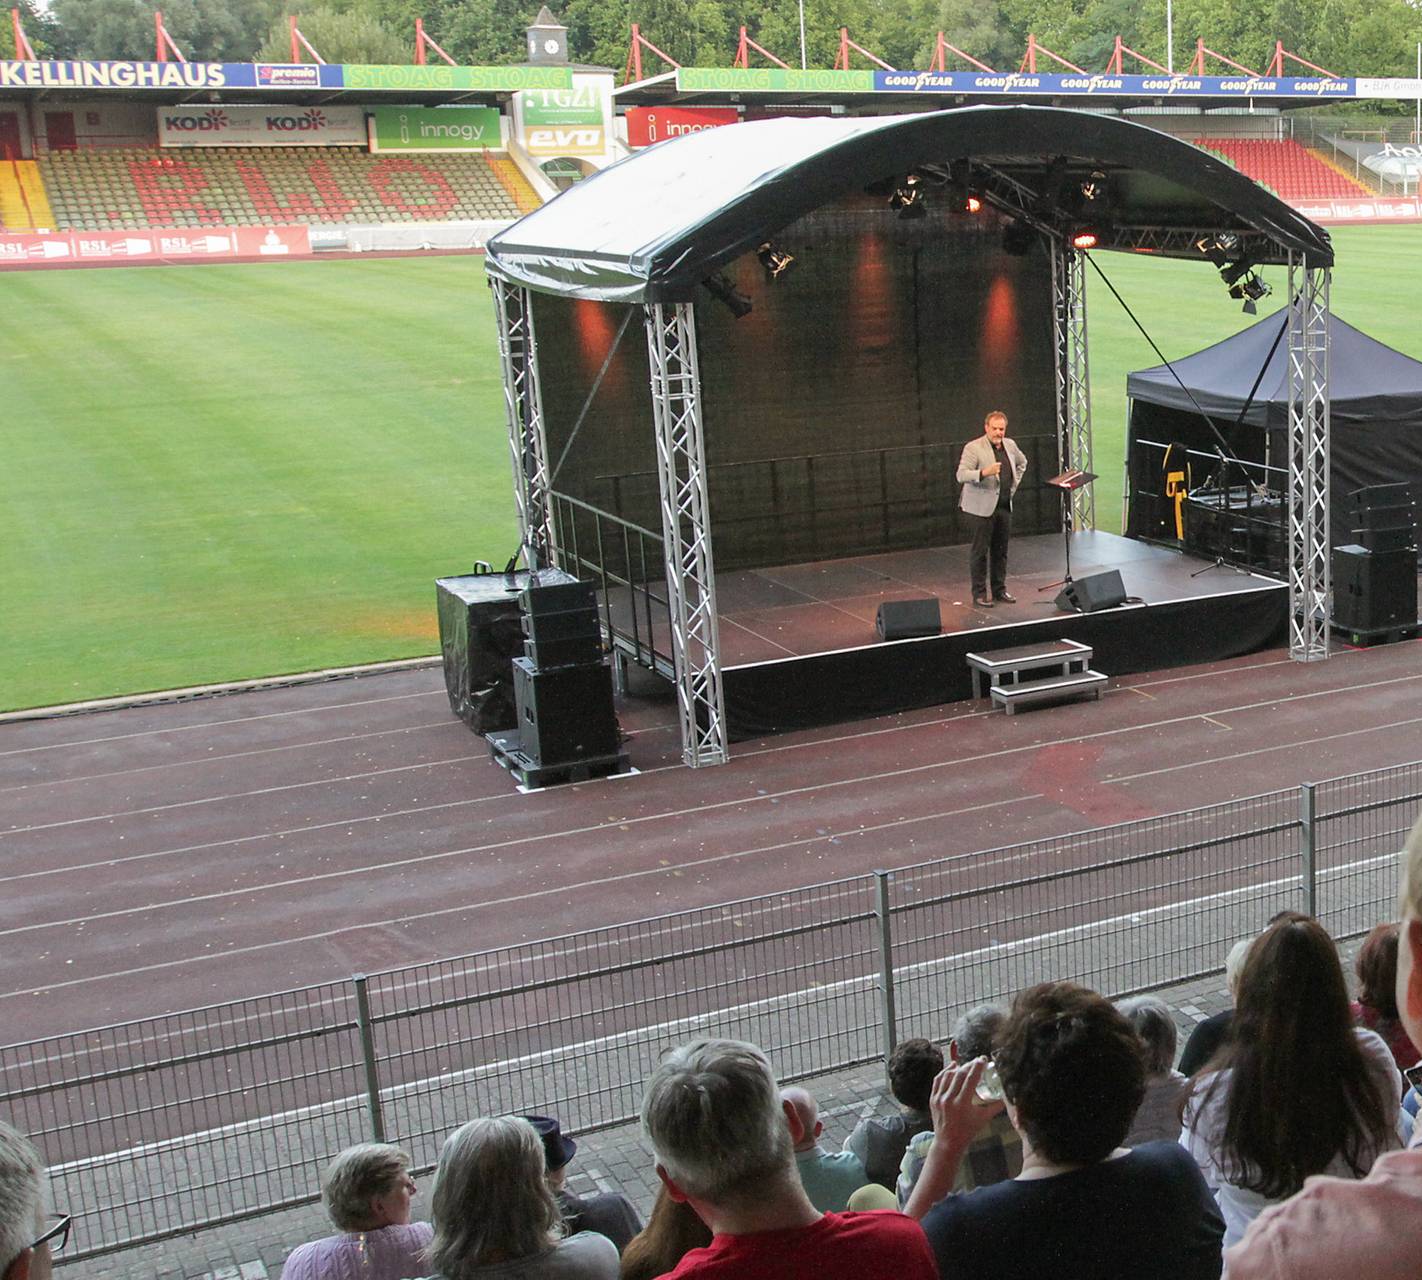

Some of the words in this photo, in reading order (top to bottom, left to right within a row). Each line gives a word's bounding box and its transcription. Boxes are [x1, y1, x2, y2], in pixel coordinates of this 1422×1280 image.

[1, 62, 225, 86] KELLINGHAUS
[350, 65, 453, 87] STOAG
[471, 67, 567, 88] STOAG
[683, 69, 770, 90] STOAG
[786, 71, 869, 90] STOAG
[420, 121, 484, 140] innogy
[529, 130, 600, 147] evo
[667, 121, 717, 137] inno
[79, 240, 110, 251] RSL
[160, 237, 191, 249] RSL
